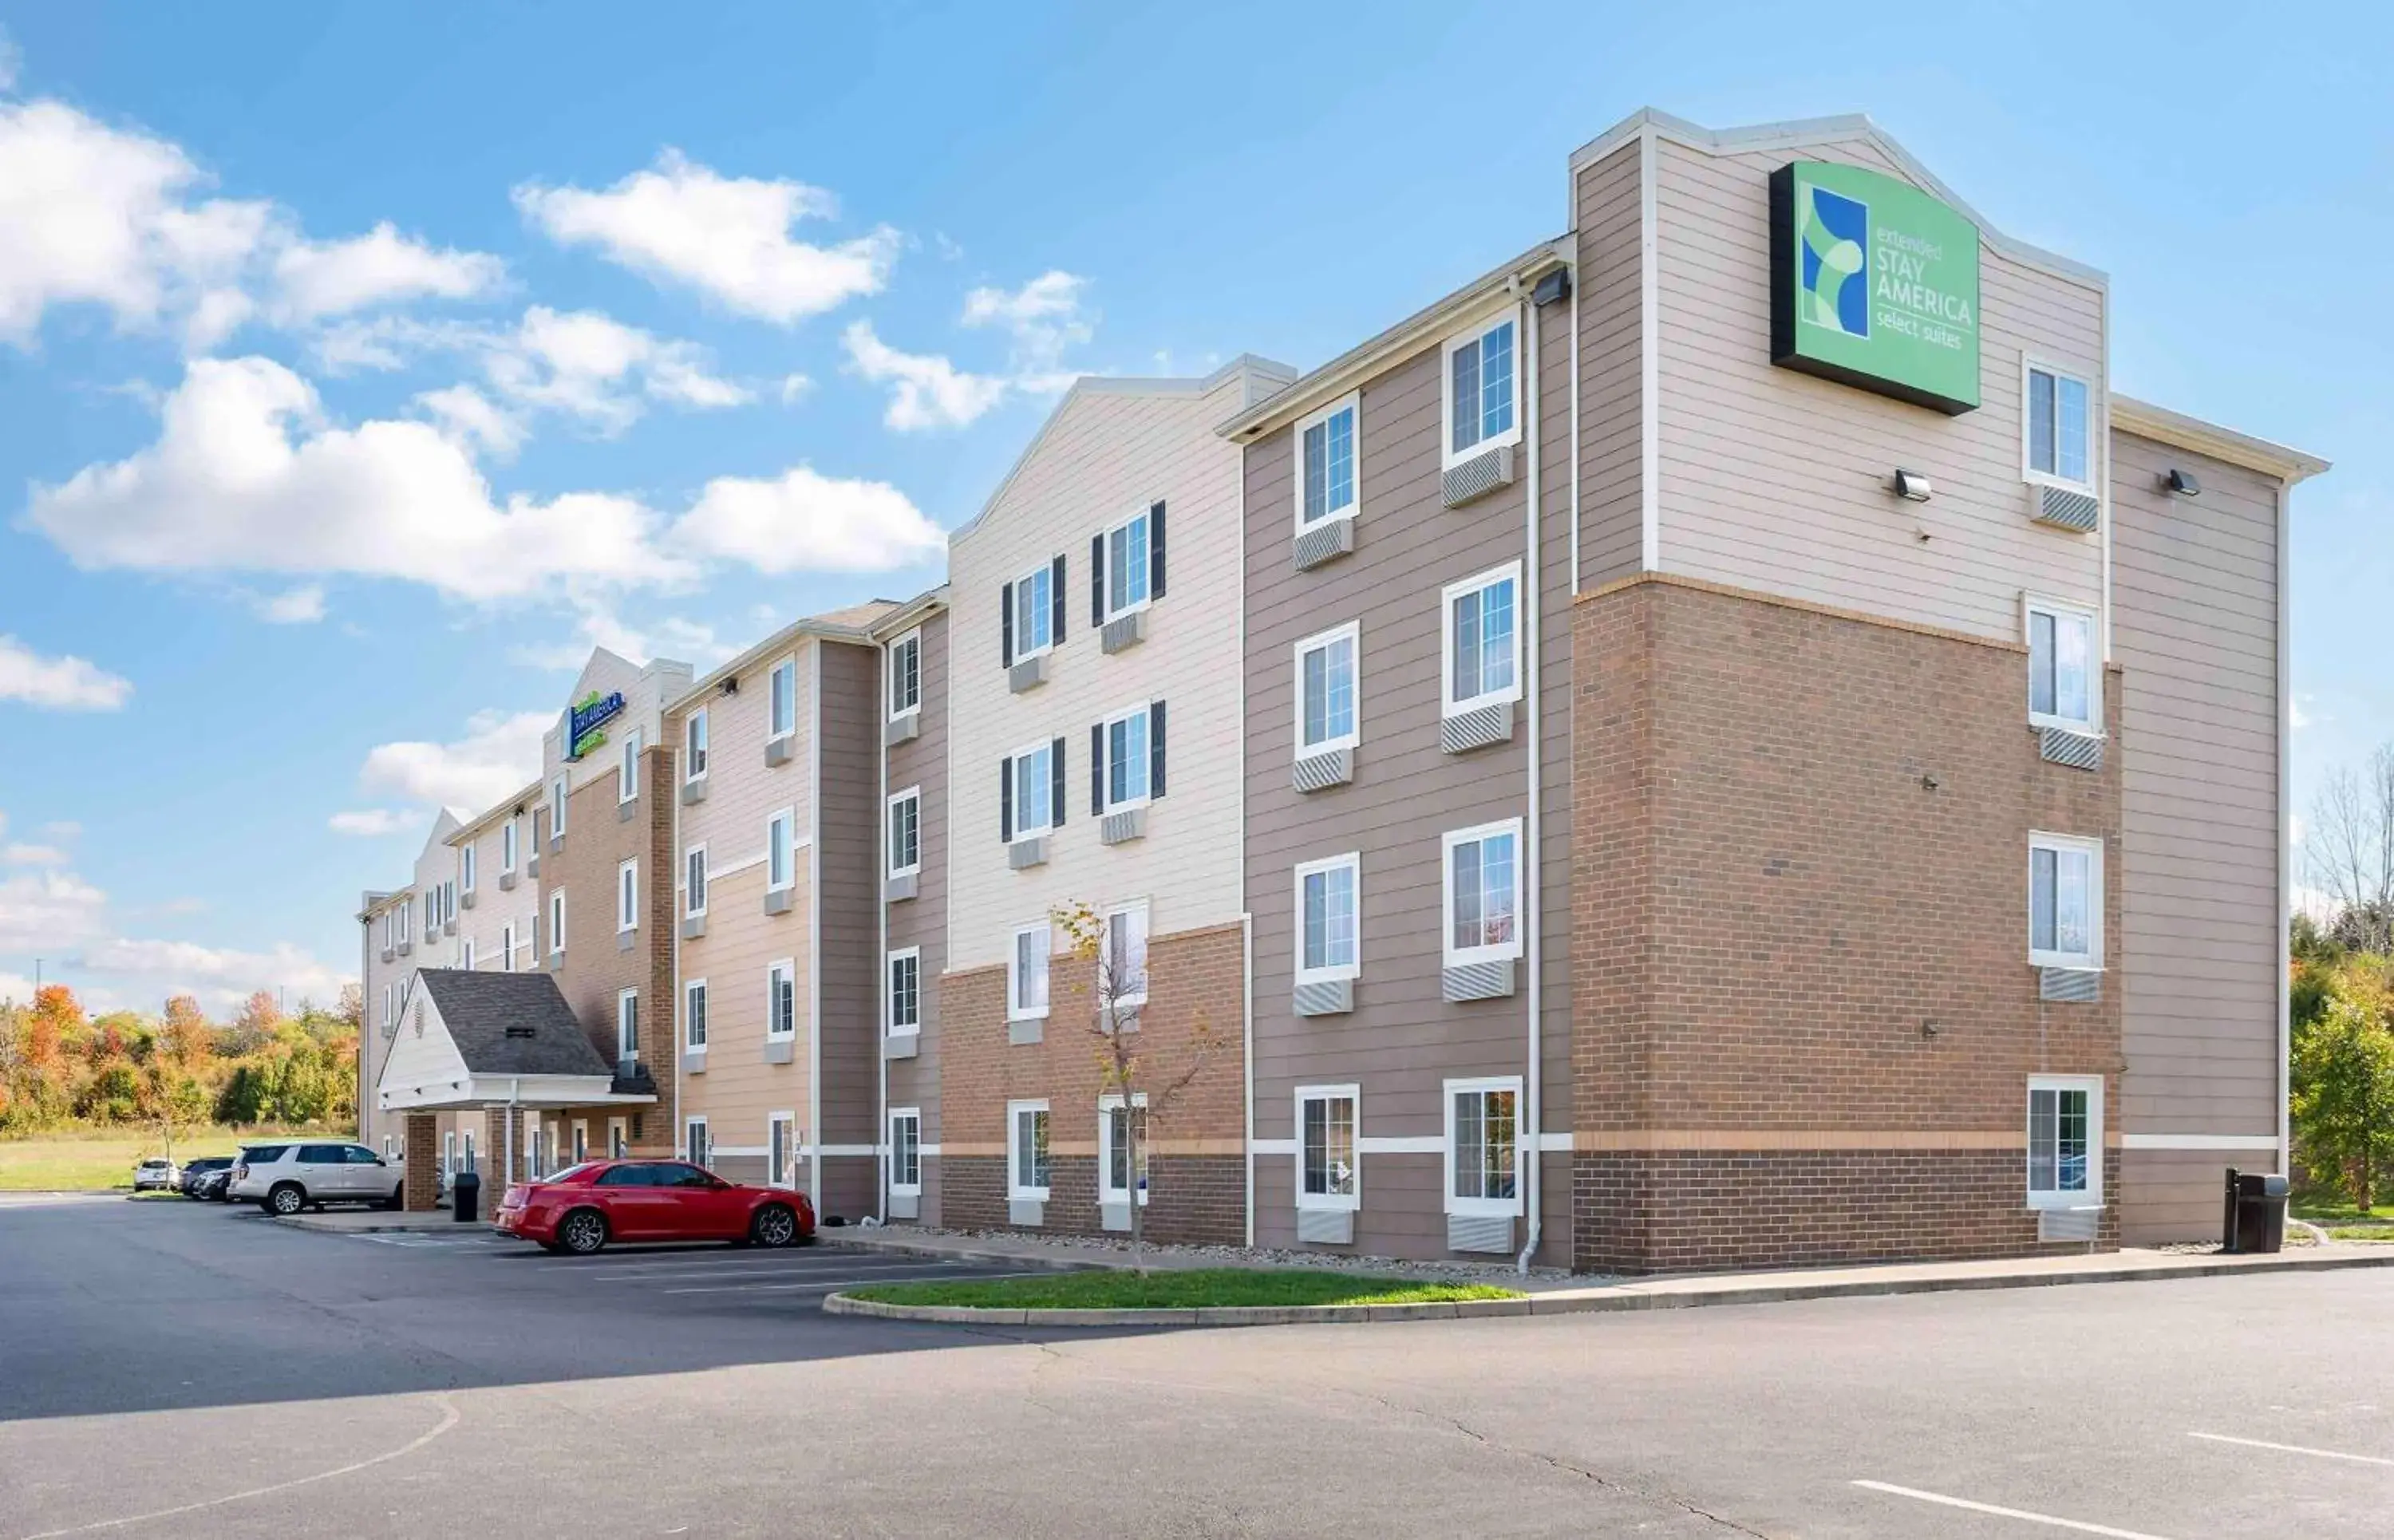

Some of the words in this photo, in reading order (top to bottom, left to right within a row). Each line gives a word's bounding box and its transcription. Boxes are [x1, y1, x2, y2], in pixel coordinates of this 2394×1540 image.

[1876, 245, 1926, 282] STAY
[1877, 227, 1942, 262] extended
[1876, 272, 1972, 326] AMERICA
[1876, 311, 1919, 339] select
[1922, 326, 1962, 350] suites
